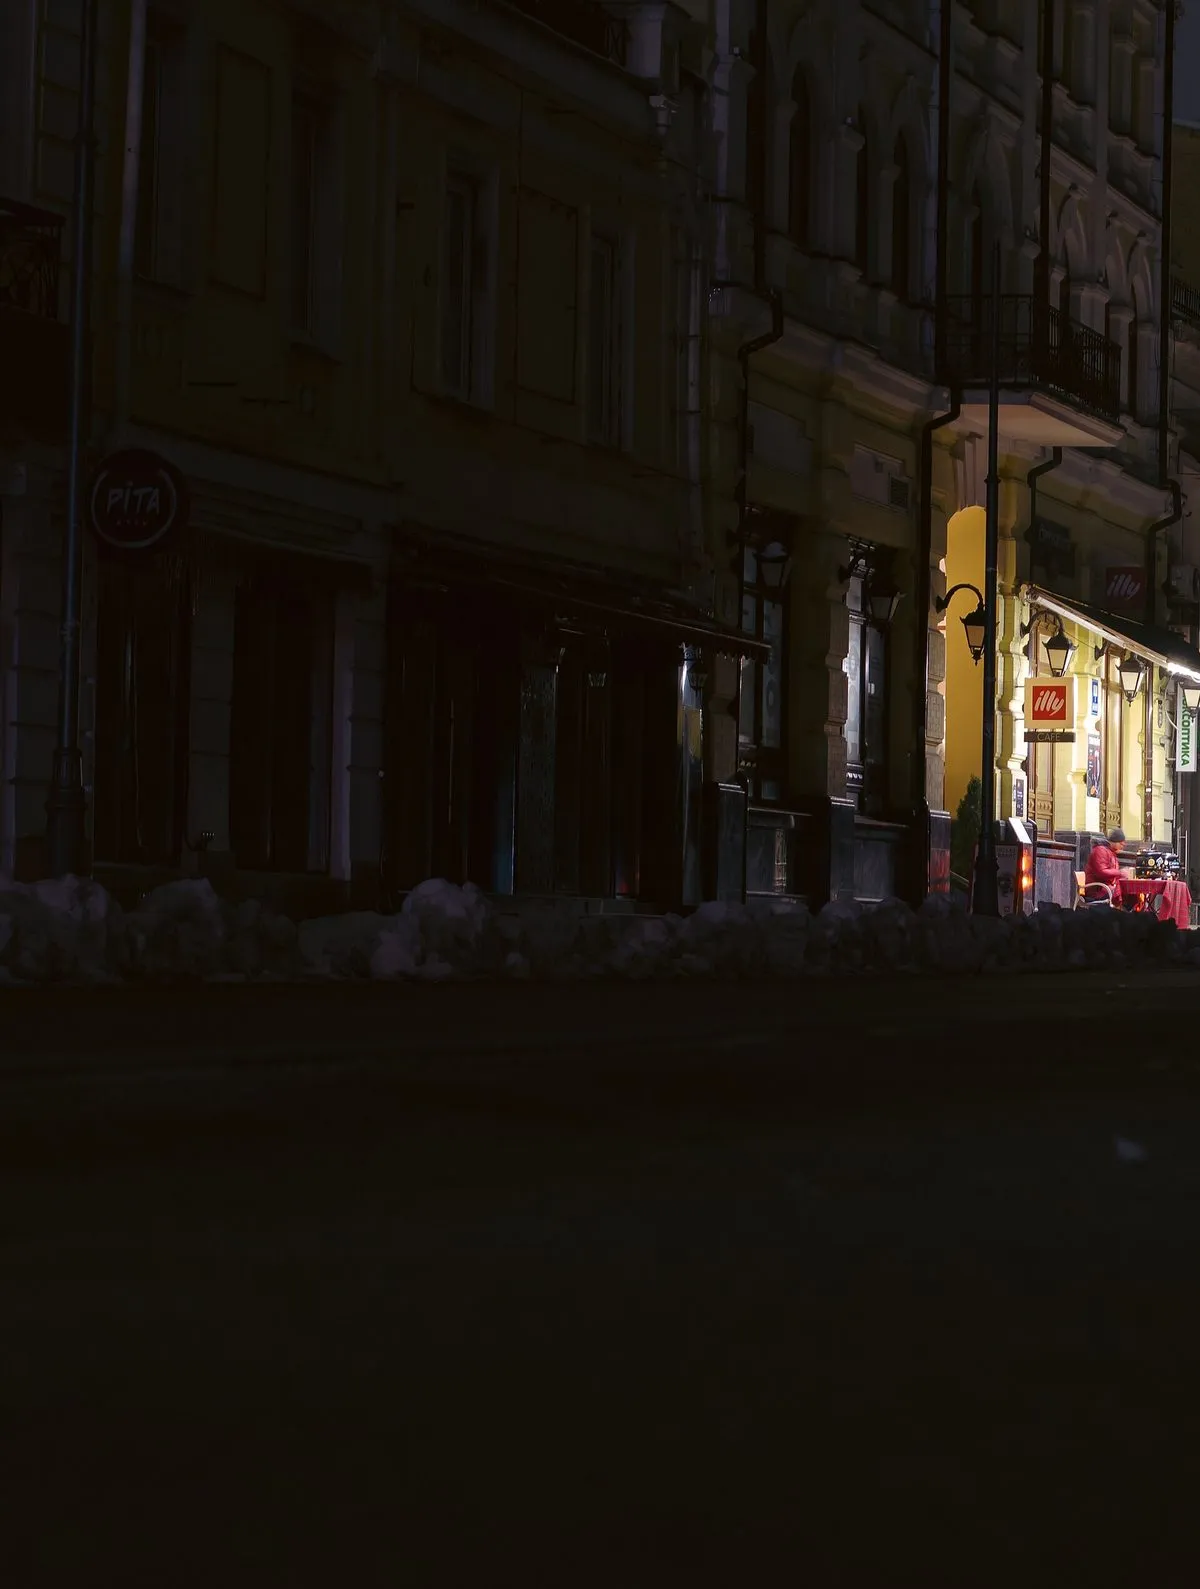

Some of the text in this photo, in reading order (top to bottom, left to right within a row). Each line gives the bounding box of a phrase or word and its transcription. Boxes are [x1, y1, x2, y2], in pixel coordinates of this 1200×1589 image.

[1106, 573, 1141, 601] illy
[1034, 690, 1065, 717] illy
[1036, 732, 1061, 742] CAFE
